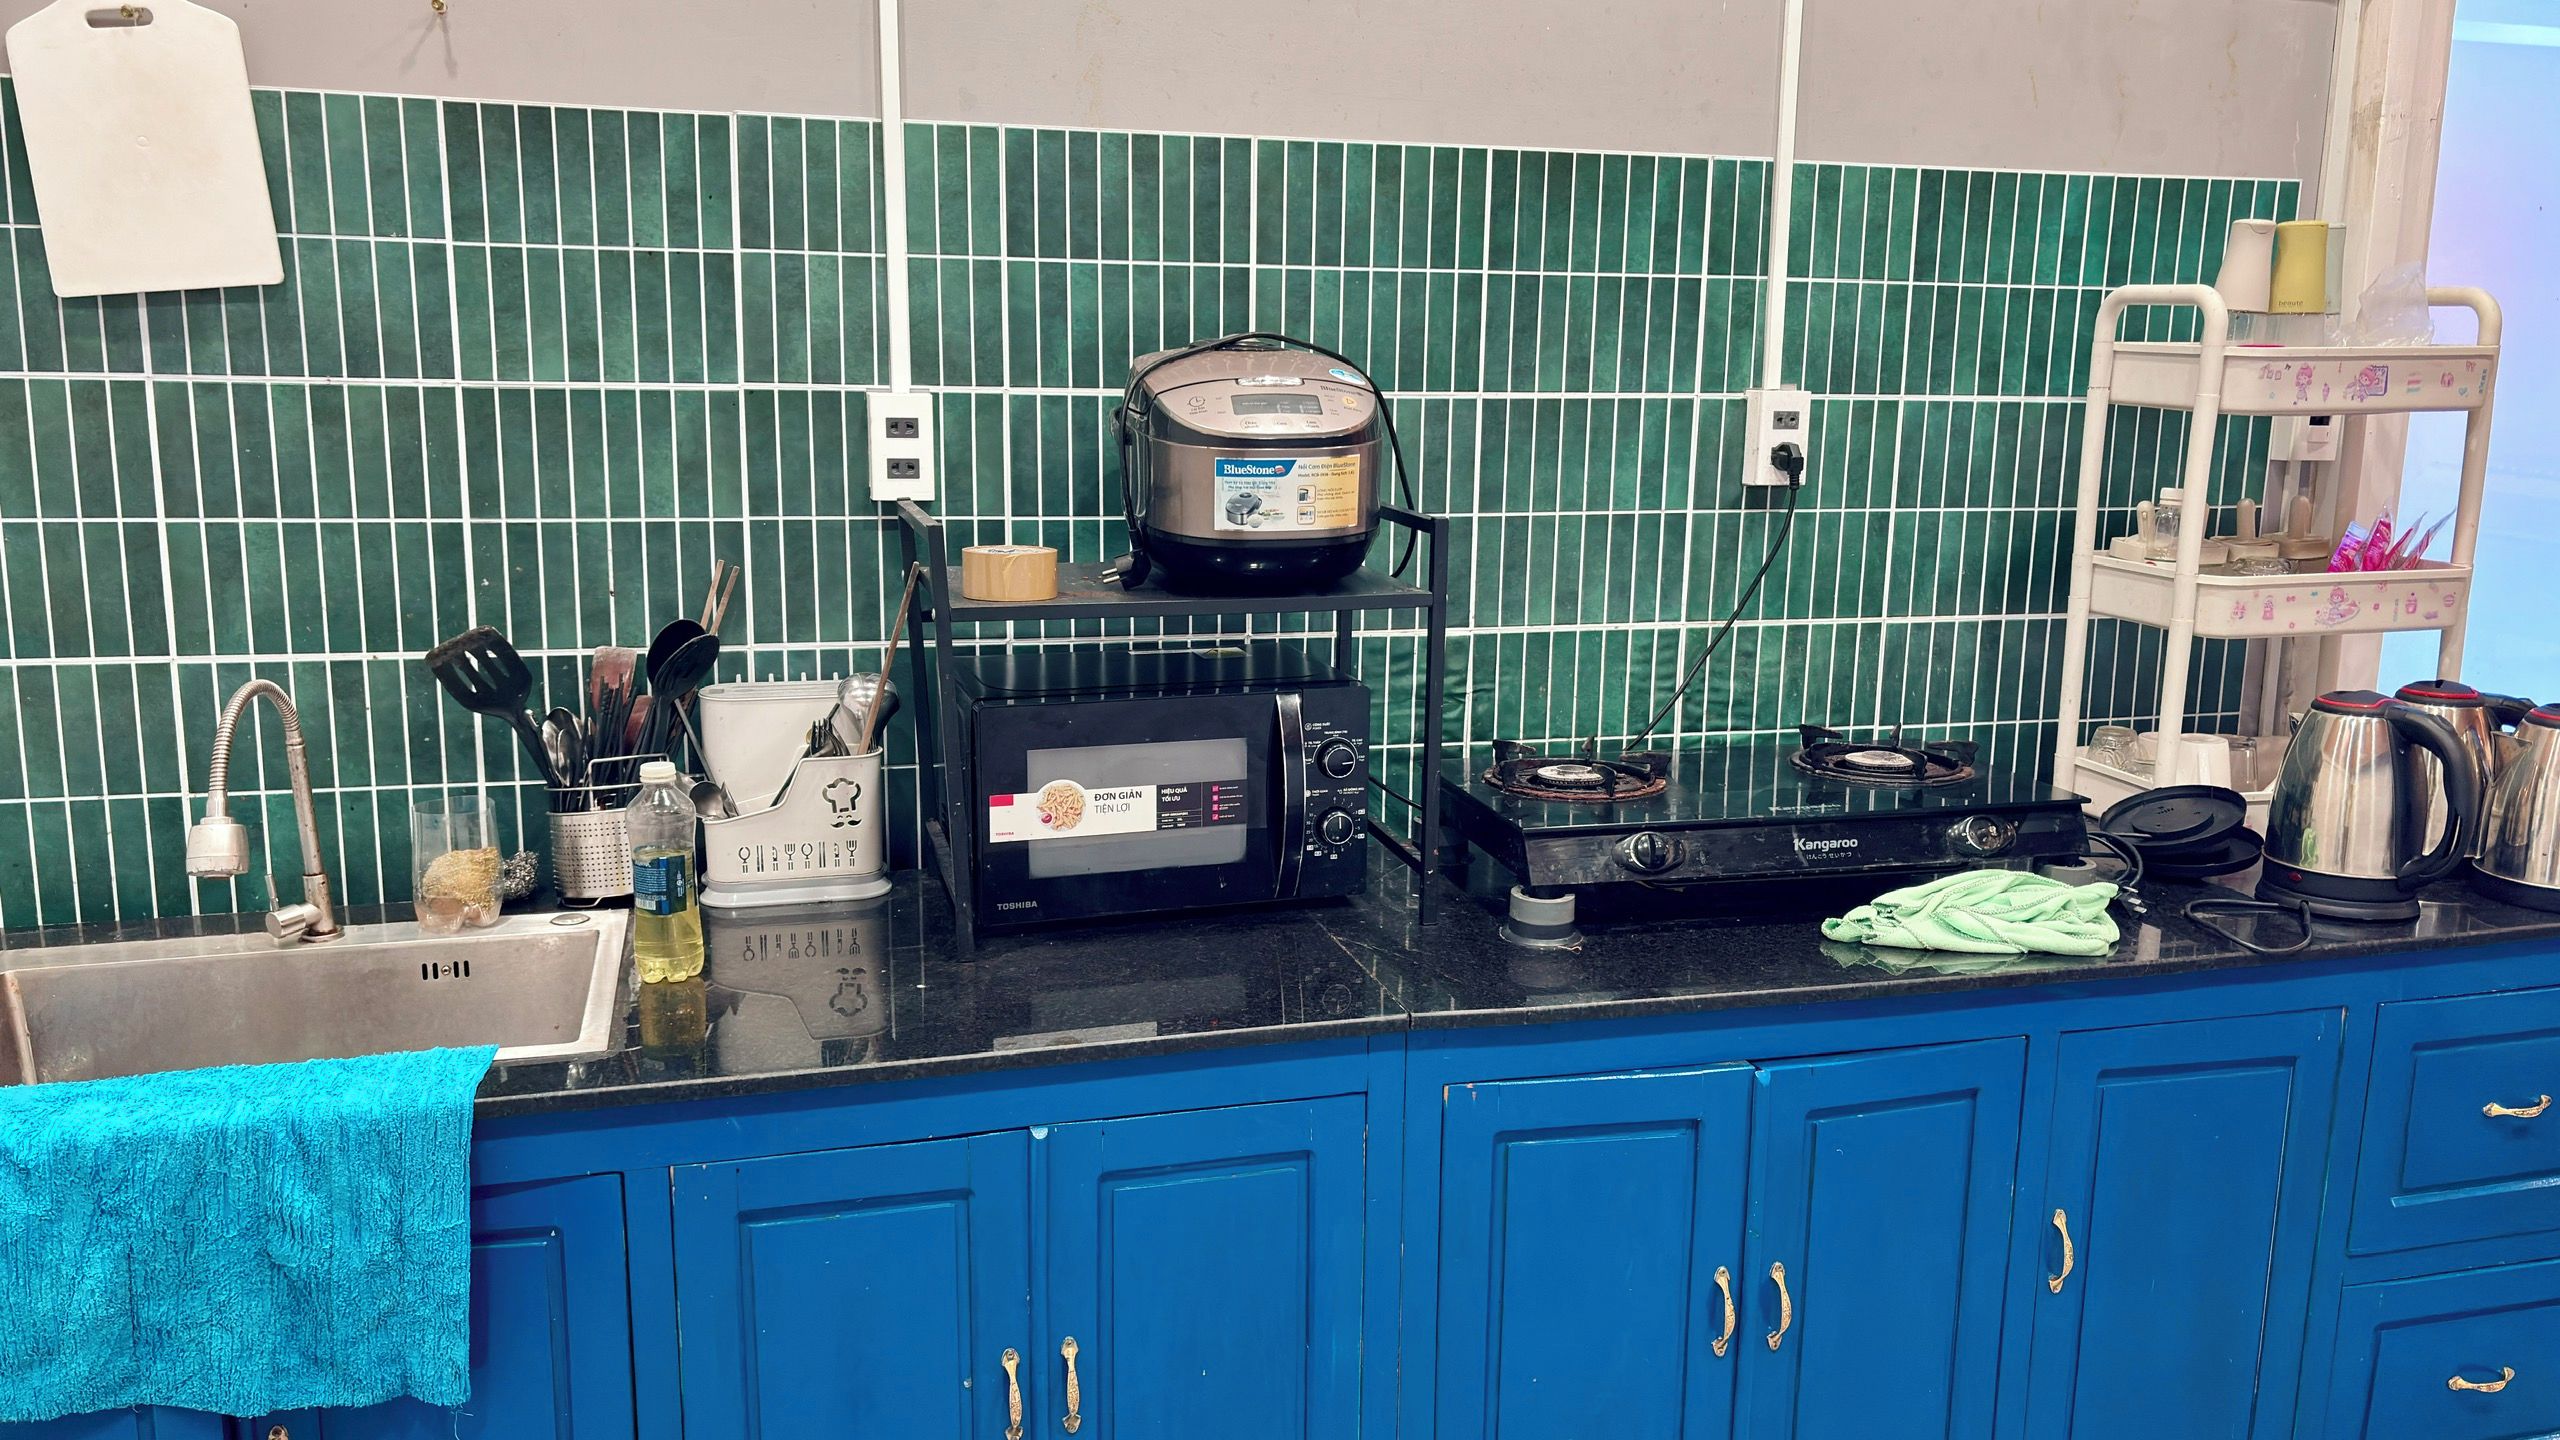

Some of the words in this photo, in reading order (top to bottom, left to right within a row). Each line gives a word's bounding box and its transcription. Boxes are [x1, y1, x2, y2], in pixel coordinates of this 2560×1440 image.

[1223, 464, 1275, 475] BlueStone
[1094, 792, 1117, 802] ĐƠN
[1118, 788, 1142, 800] GIẢN
[1161, 787, 1175, 795] HIỆU
[1095, 803, 1114, 815] TIỆN
[1116, 802, 1131, 814] LỢI
[1793, 838, 1858, 852] Kangaroo
[996, 900, 1038, 911] TOSHIBA
